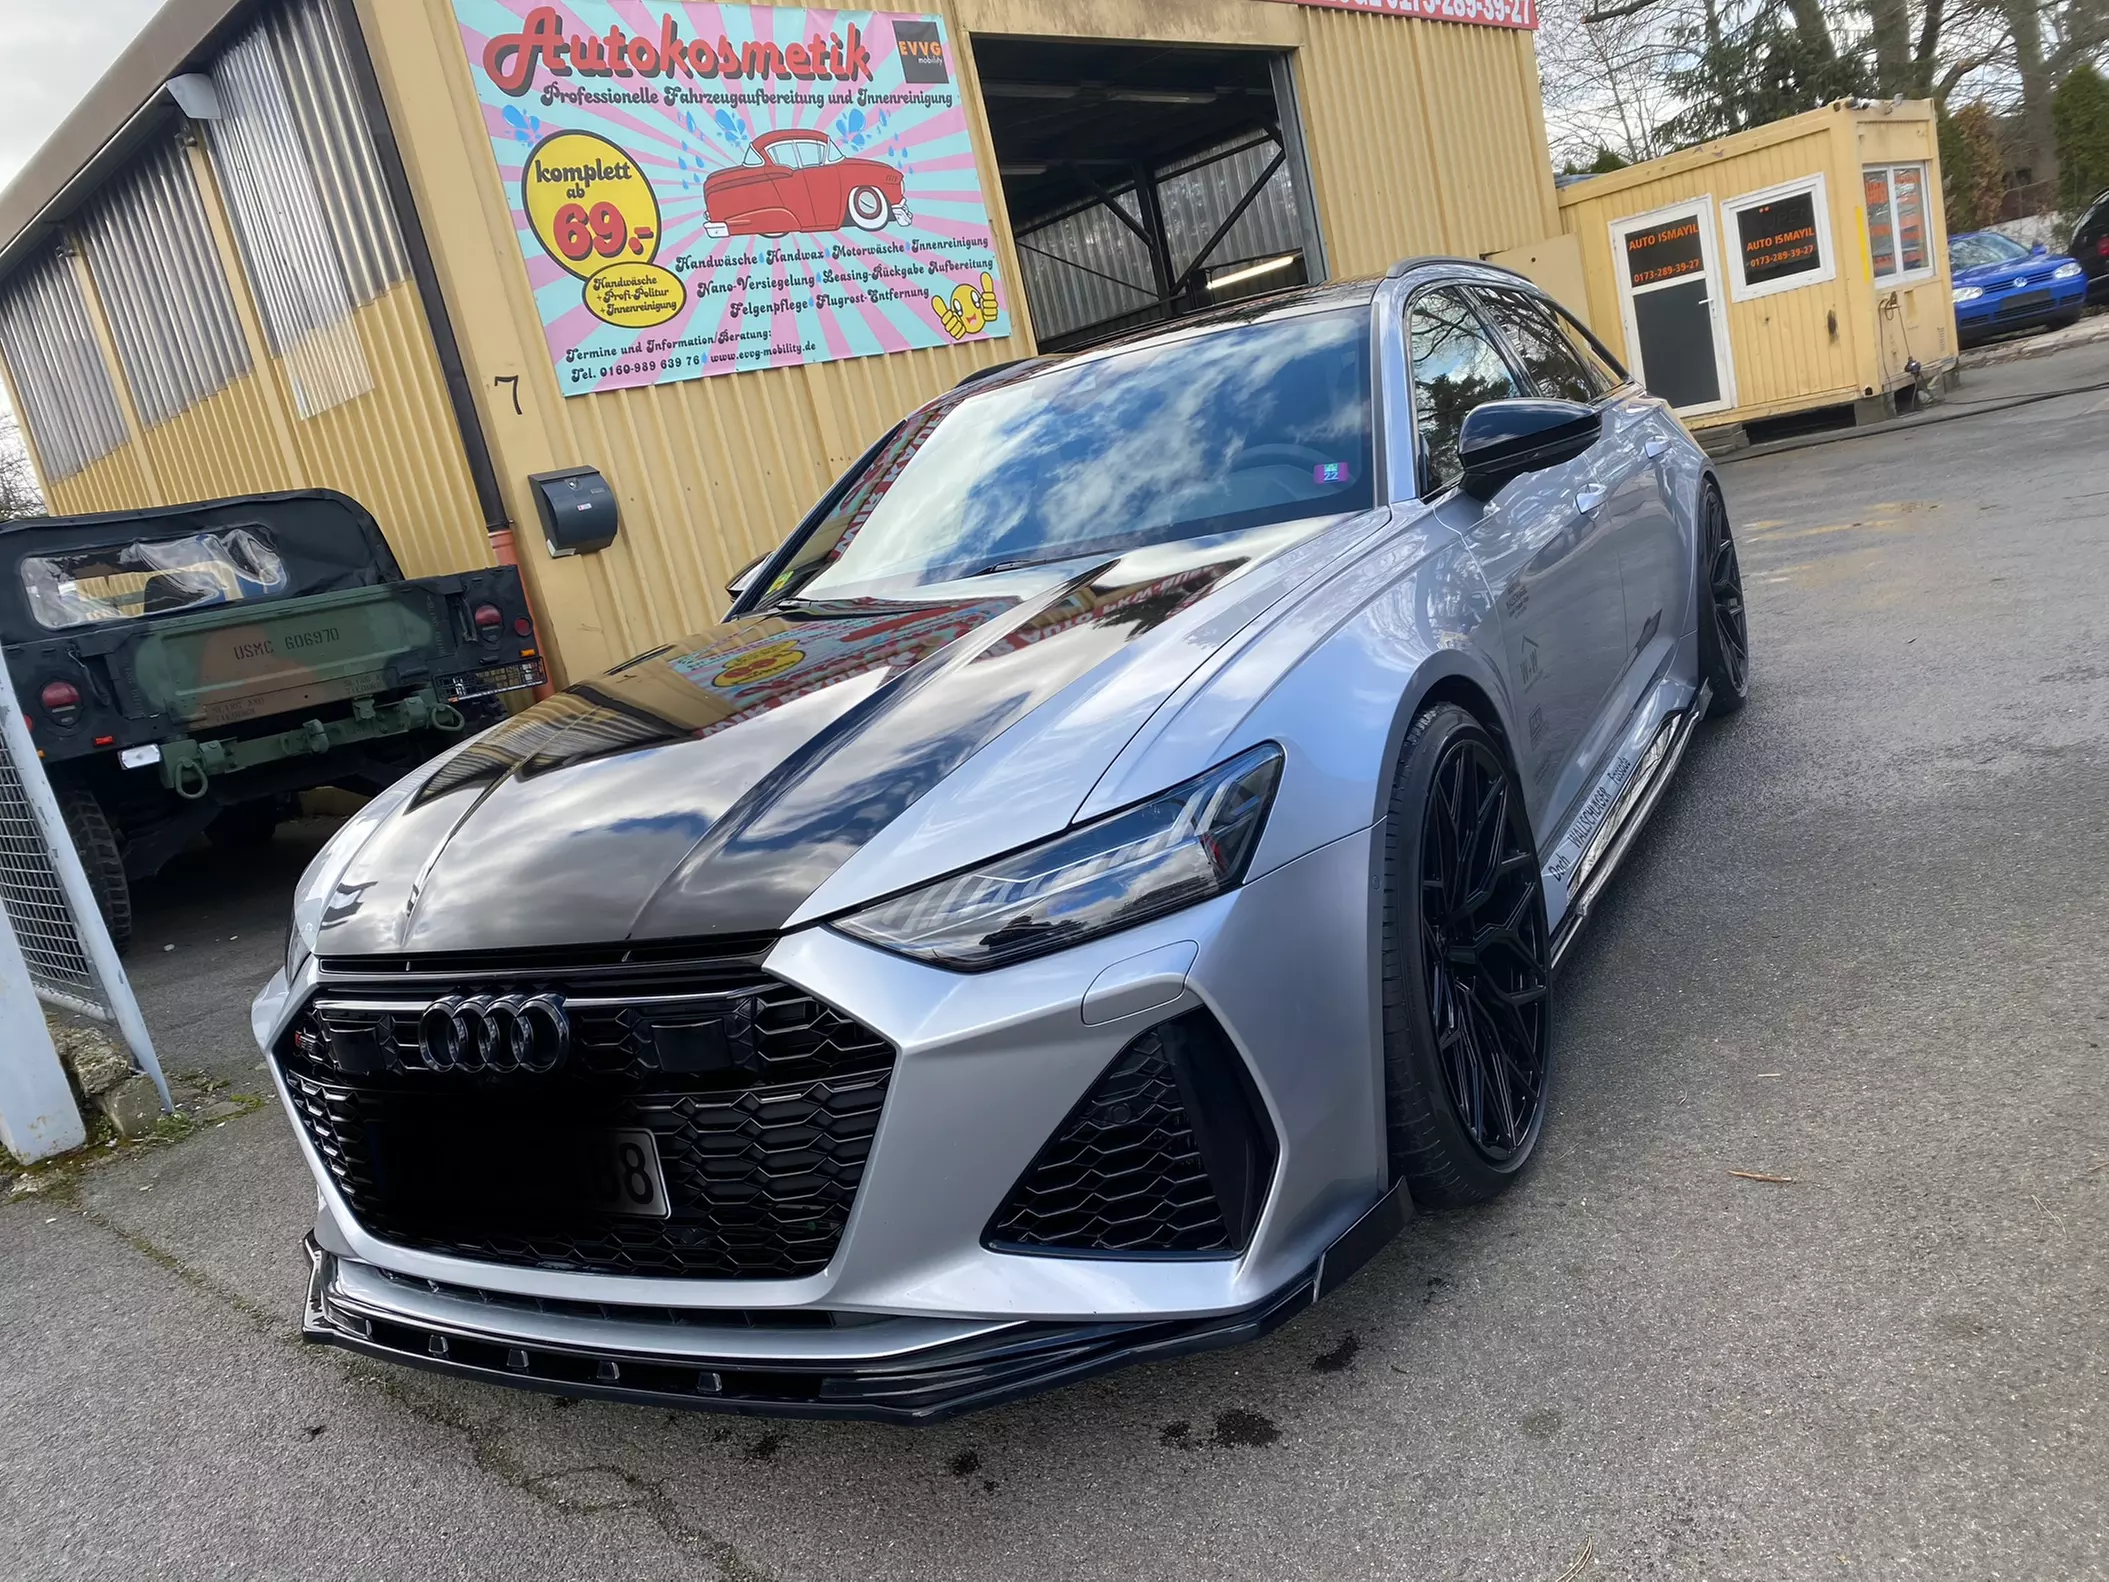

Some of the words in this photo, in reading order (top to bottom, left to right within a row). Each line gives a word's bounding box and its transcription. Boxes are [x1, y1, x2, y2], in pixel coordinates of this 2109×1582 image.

[483, 6, 873, 97] Autokosmetik
[899, 40, 942, 56] EVVG
[918, 56, 943, 66] mobility
[540, 82, 659, 107] Professionelle
[663, 86, 825, 109] Fahrzeugaufbereitung
[828, 89, 852, 105] und
[856, 89, 953, 108] Innenreinigung
[535, 158, 632, 187] komplett
[566, 183, 586, 199] ab
[553, 201, 654, 261] 69.-
[1629, 235, 1656, 251] AUTO
[1658, 224, 1698, 242] ISMAYIL
[1746, 237, 1772, 252] AUTO
[1775, 227, 1815, 245] ISMAYIL
[675, 252, 758, 272] Handwäsche
[766, 248, 824, 266] Handwax
[832, 241, 905, 260] Motorwäsche
[911, 237, 988, 253] Innenreinigung
[1750, 244, 1814, 268] 0173-289-39-27
[592, 275, 657, 291] Handwäsche
[697, 274, 815, 298] Nano-Versiegelung
[823, 263, 924, 284] Leasing-Rückgabe
[928, 259, 994, 275] Aufbereitung
[1634, 258, 1700, 283] 0173-289-39-27
[730, 298, 808, 318] Felgenpflege
[816, 287, 930, 310] Flugrost-Entfernung
[565, 347, 617, 363] Termine
[621, 342, 642, 355] und
[646, 329, 772, 353] Information/Beratung:
[710, 340, 816, 364] www.evvg-mobility.de
[571, 368, 596, 383] Tel.
[600, 361, 656, 378] 0160-989
[660, 357, 682, 370] 639
[686, 355, 700, 366] 76
[494, 374, 523, 415] 7
[233, 640, 275, 660] USMC
[285, 627, 340, 650] 606970
